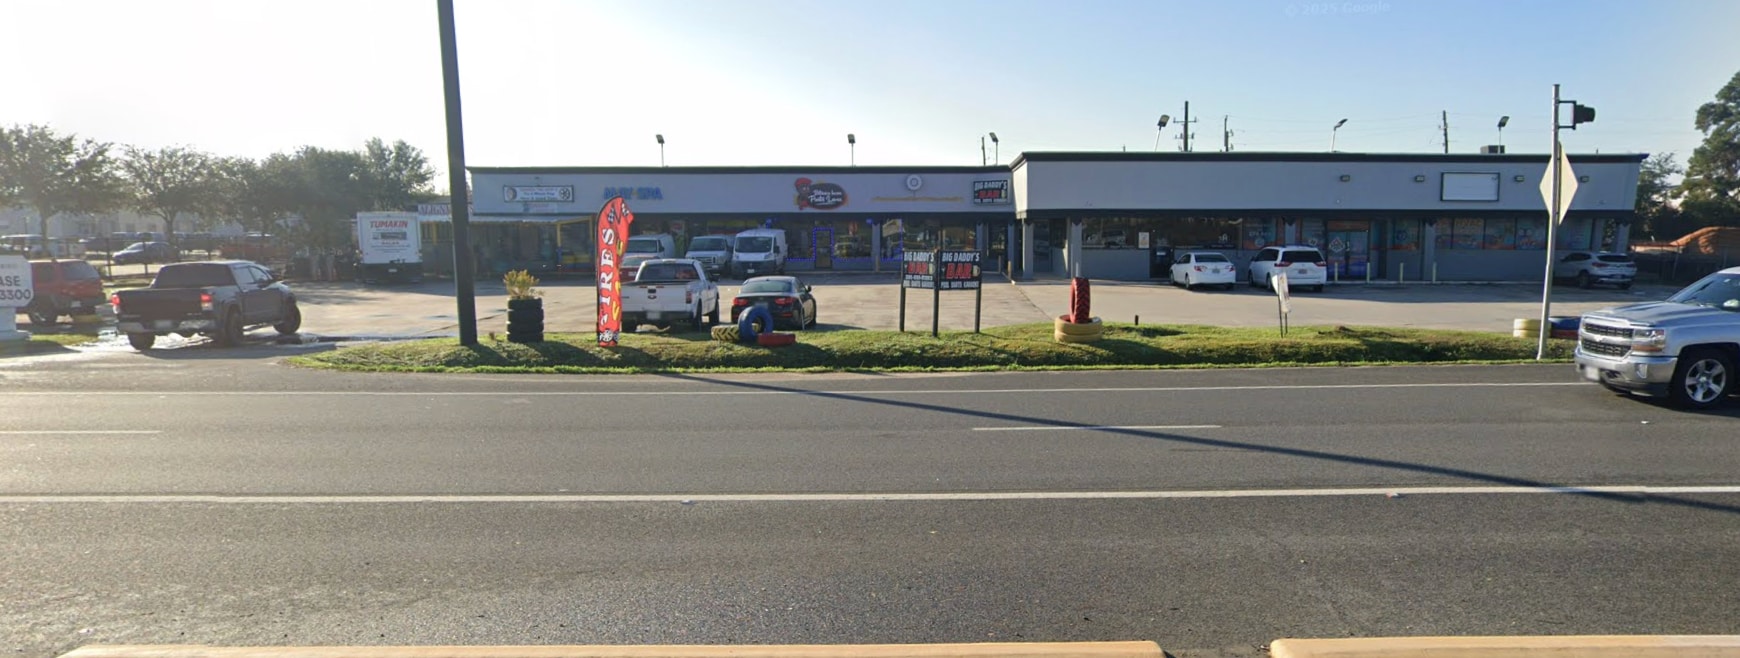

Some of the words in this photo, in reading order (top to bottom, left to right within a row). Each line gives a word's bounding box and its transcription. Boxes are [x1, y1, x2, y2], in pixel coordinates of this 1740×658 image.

[904, 252, 912, 261] BIG
[942, 252, 953, 262] BIG
[953, 252, 980, 262] DADDY'S
[907, 261, 928, 274] BAR
[946, 263, 972, 279] BAR
